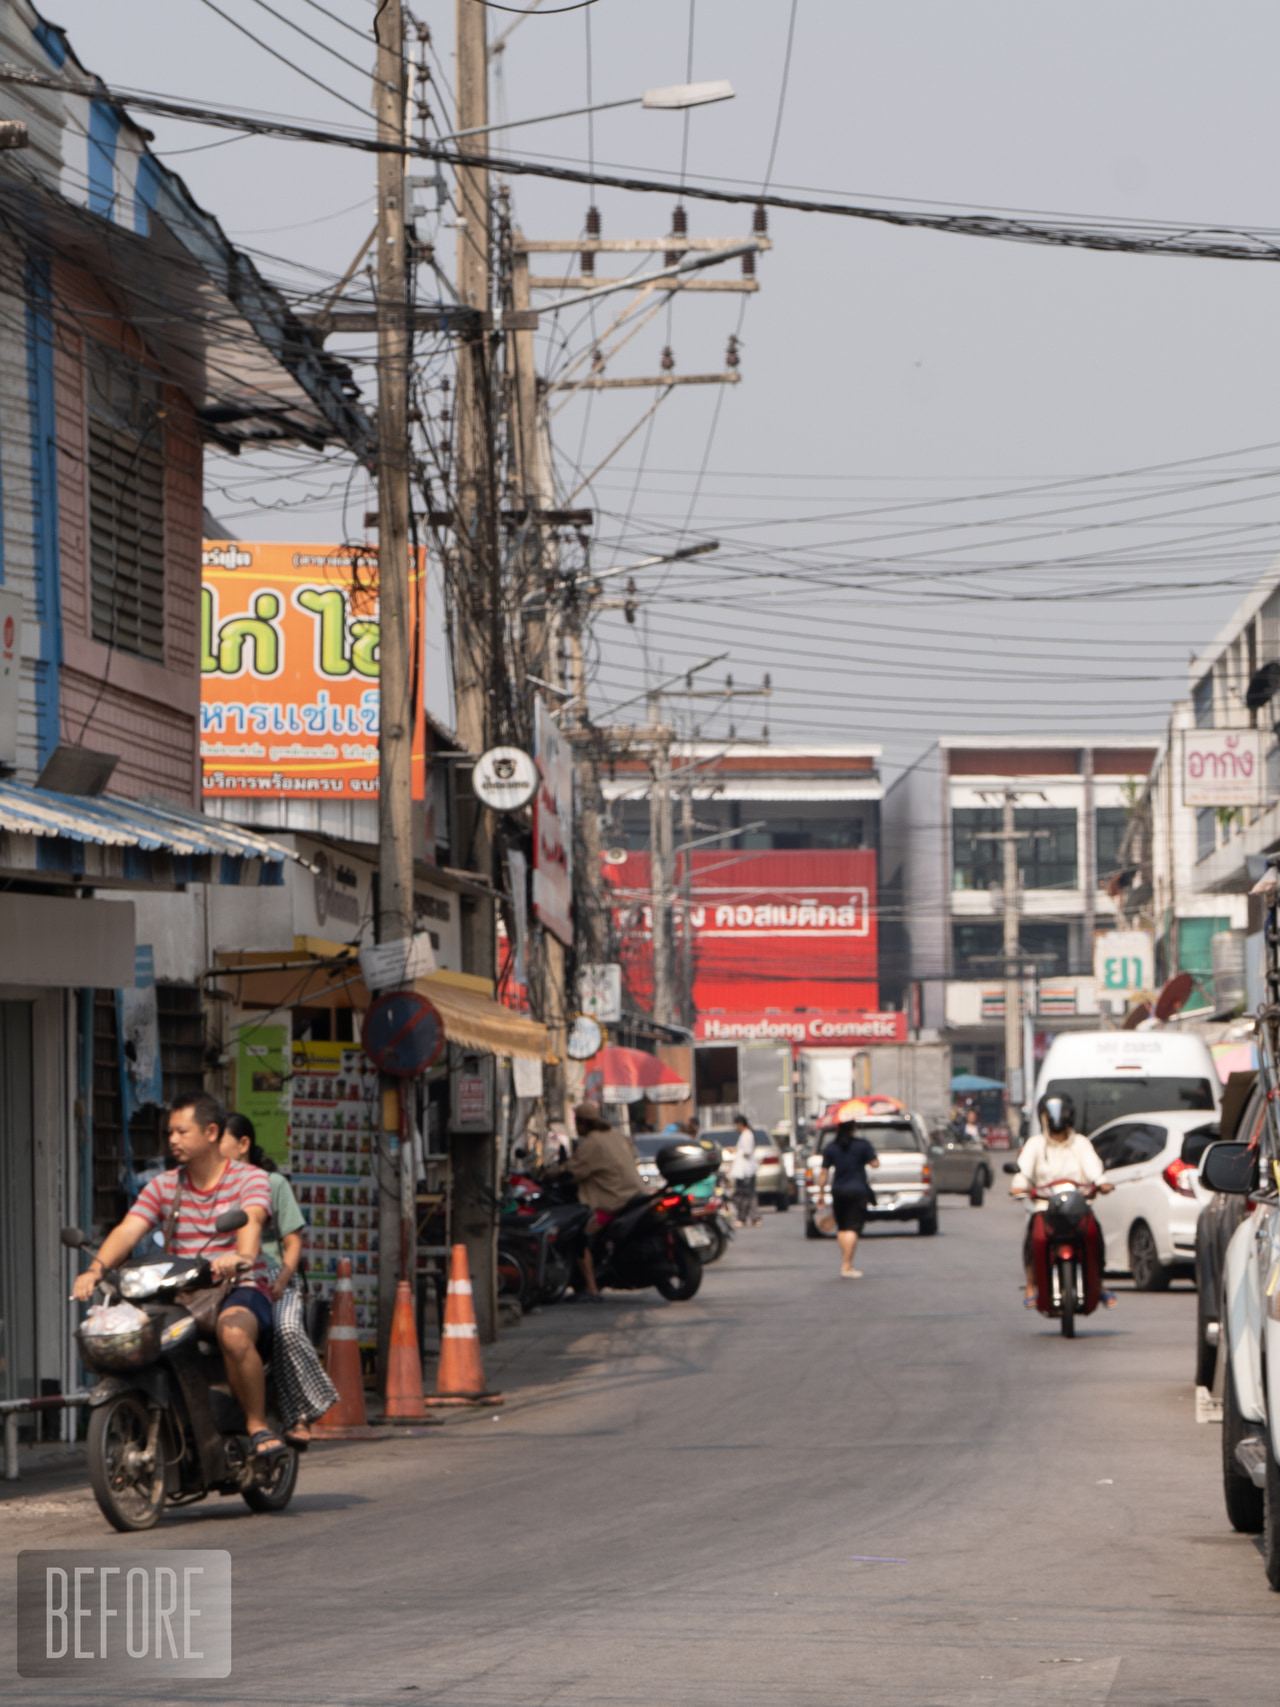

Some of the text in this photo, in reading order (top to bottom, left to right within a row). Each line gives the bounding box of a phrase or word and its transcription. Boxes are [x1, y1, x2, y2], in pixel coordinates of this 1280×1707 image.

[1104, 957, 1143, 991] ยา
[704, 1019, 897, 1042] Hangdong Cosmetic
